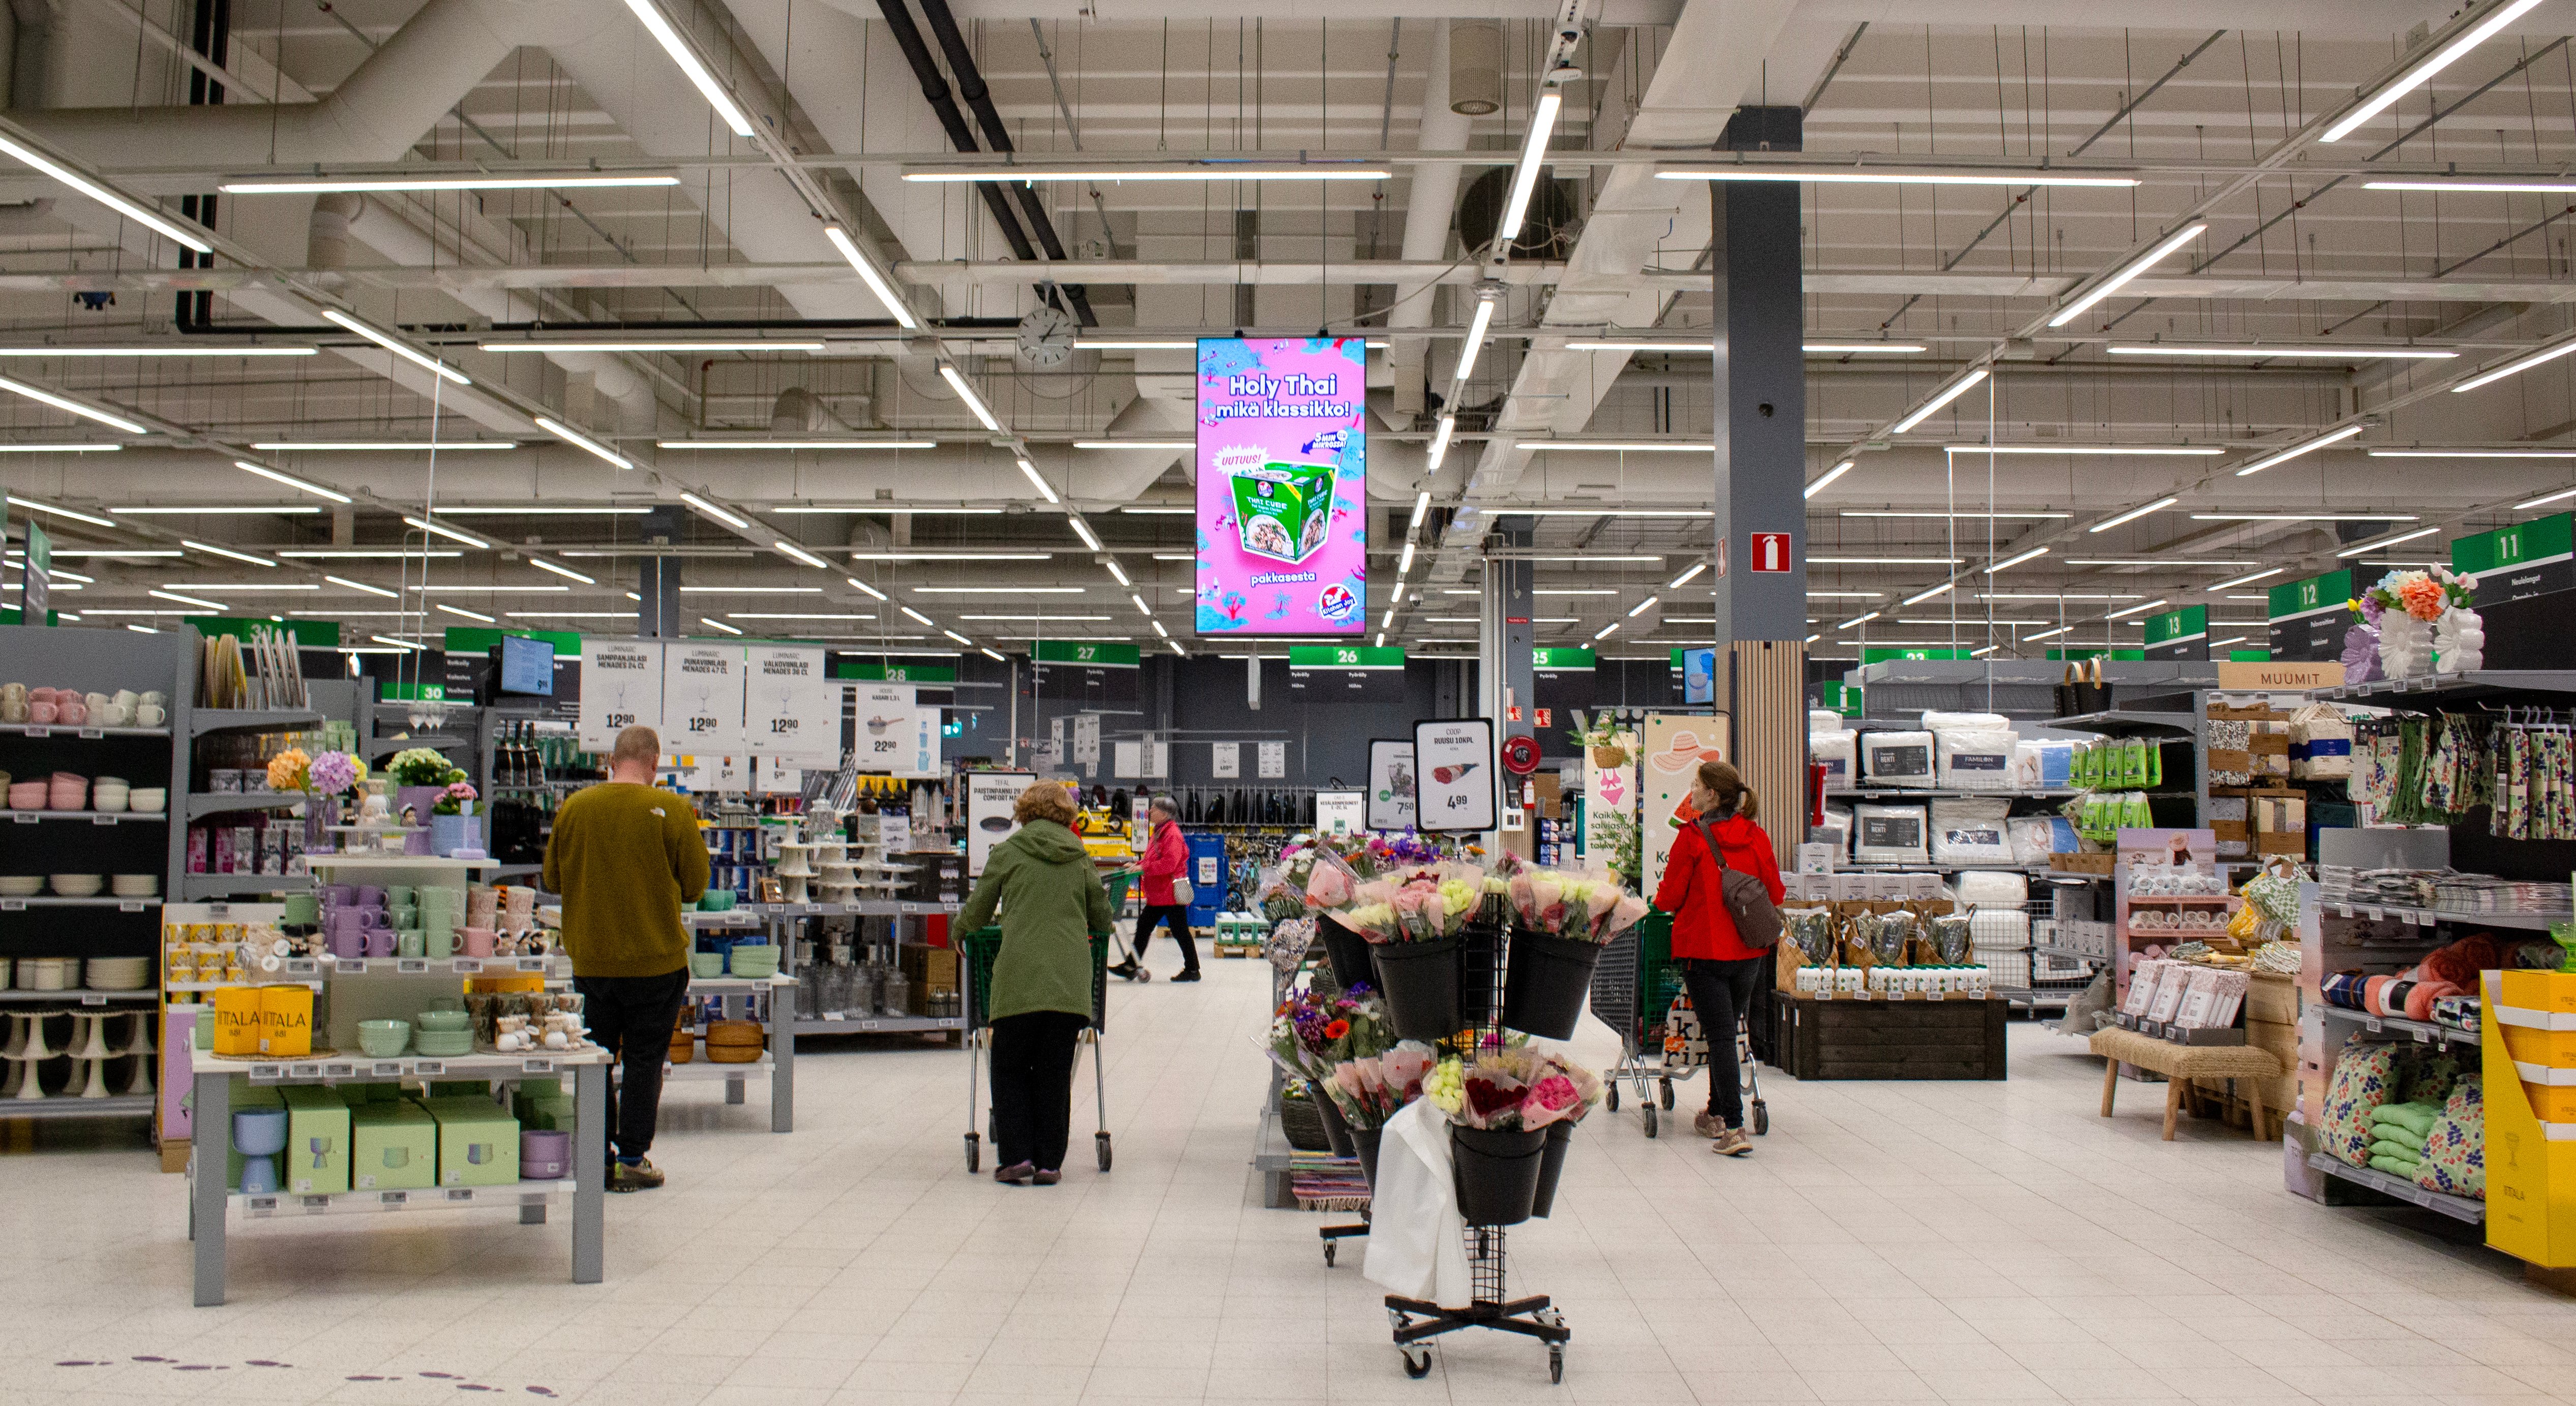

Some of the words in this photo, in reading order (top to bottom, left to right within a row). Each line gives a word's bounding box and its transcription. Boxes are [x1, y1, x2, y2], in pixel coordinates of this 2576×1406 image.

[1230, 374, 1280, 400] Holy
[1284, 374, 1337, 395] Thai
[1216, 401, 1260, 417] mikä
[1263, 400, 1350, 417] klassikko!
[1222, 454, 1261, 466] UUTUUS!
[1247, 497, 1264, 505] THAI
[1266, 500, 1287, 509] CUBE
[2500, 534, 2517, 559] 11
[1251, 571, 1316, 587] pakkasesta
[2303, 585, 2316, 604] 12
[1323, 602, 1343, 615] Kitchen
[1344, 598, 1354, 606] Joy
[2169, 617, 2179, 634] 13
[1077, 647, 1095, 659] 27
[1338, 650, 1357, 663] 26
[1533, 652, 1548, 664] 25
[887, 669, 906, 681] 28
[2261, 674, 2320, 685] MUUMIT
[425, 688, 442, 699] 30
